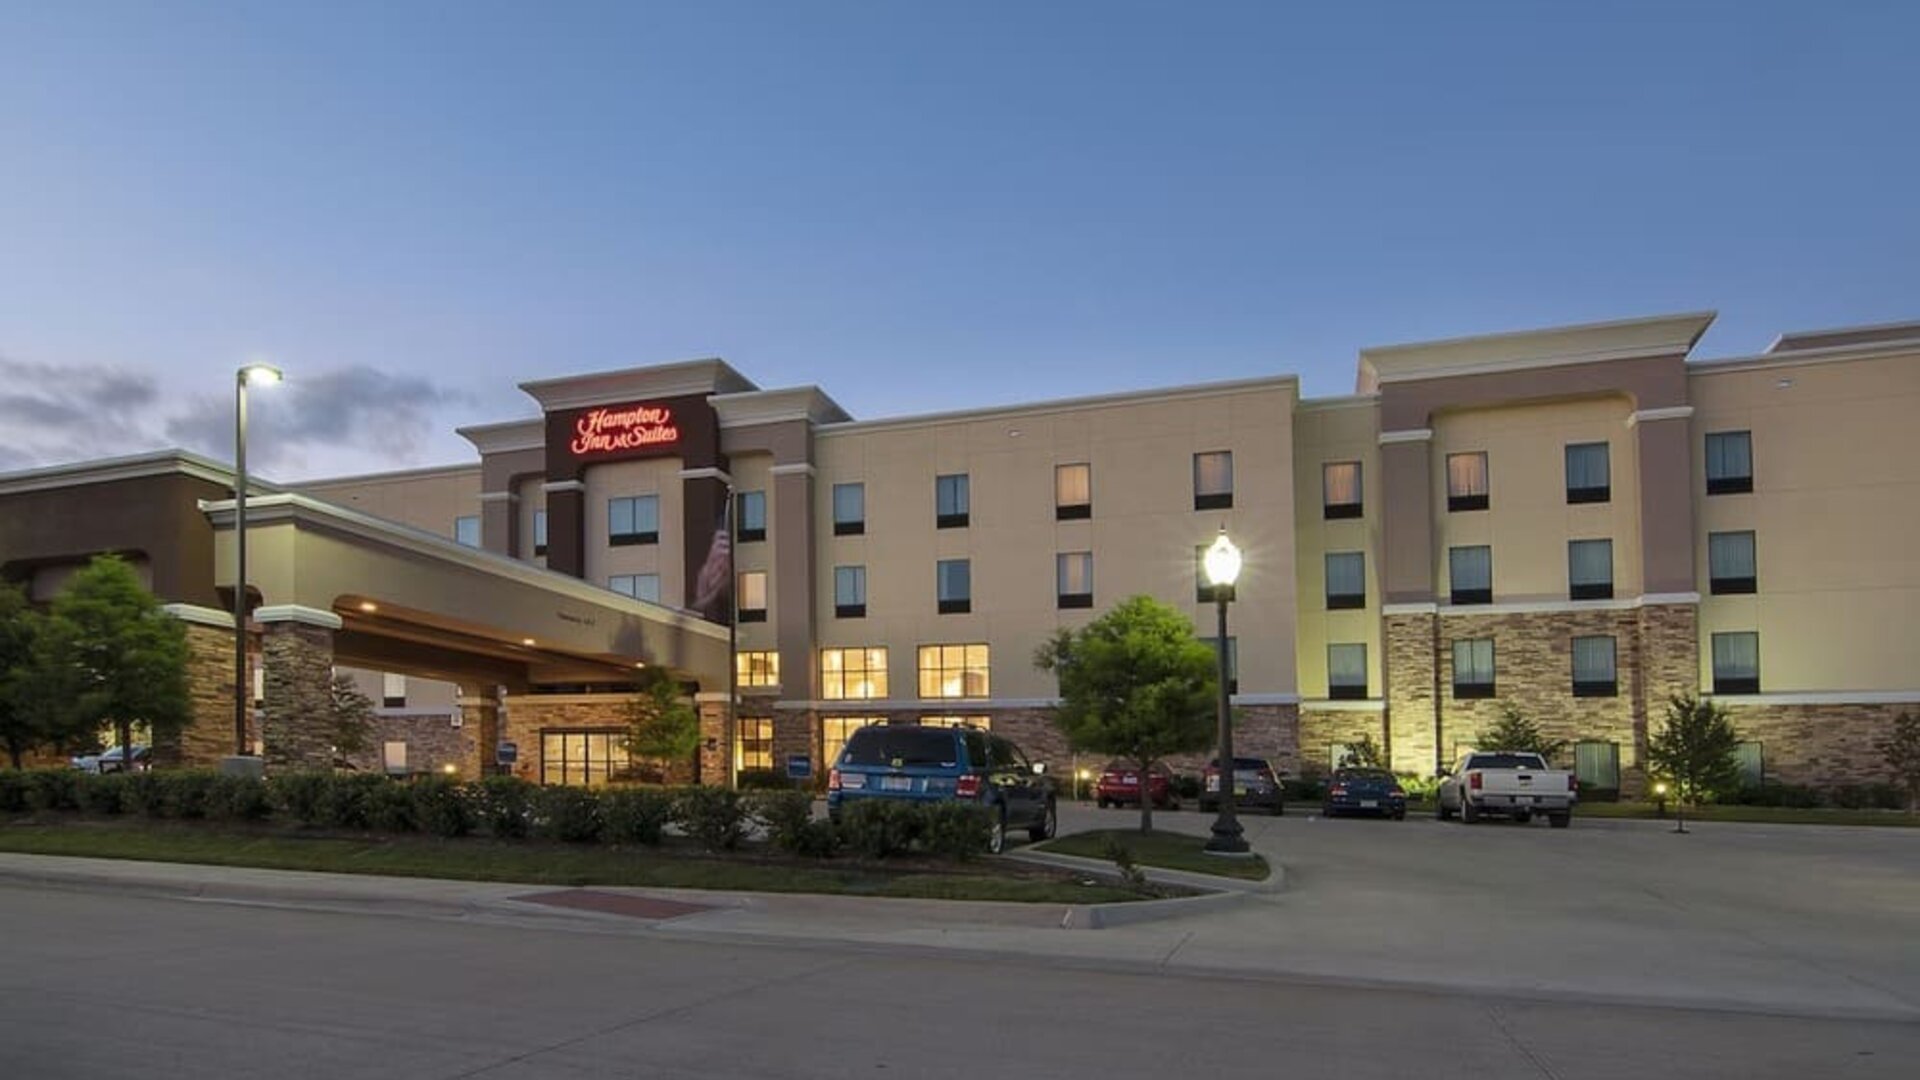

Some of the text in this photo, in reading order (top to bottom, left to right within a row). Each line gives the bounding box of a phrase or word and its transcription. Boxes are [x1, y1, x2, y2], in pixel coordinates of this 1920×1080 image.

[577, 406, 670, 434] Hampton
[571, 431, 614, 454] Inn
[627, 426, 677, 447] Suites
